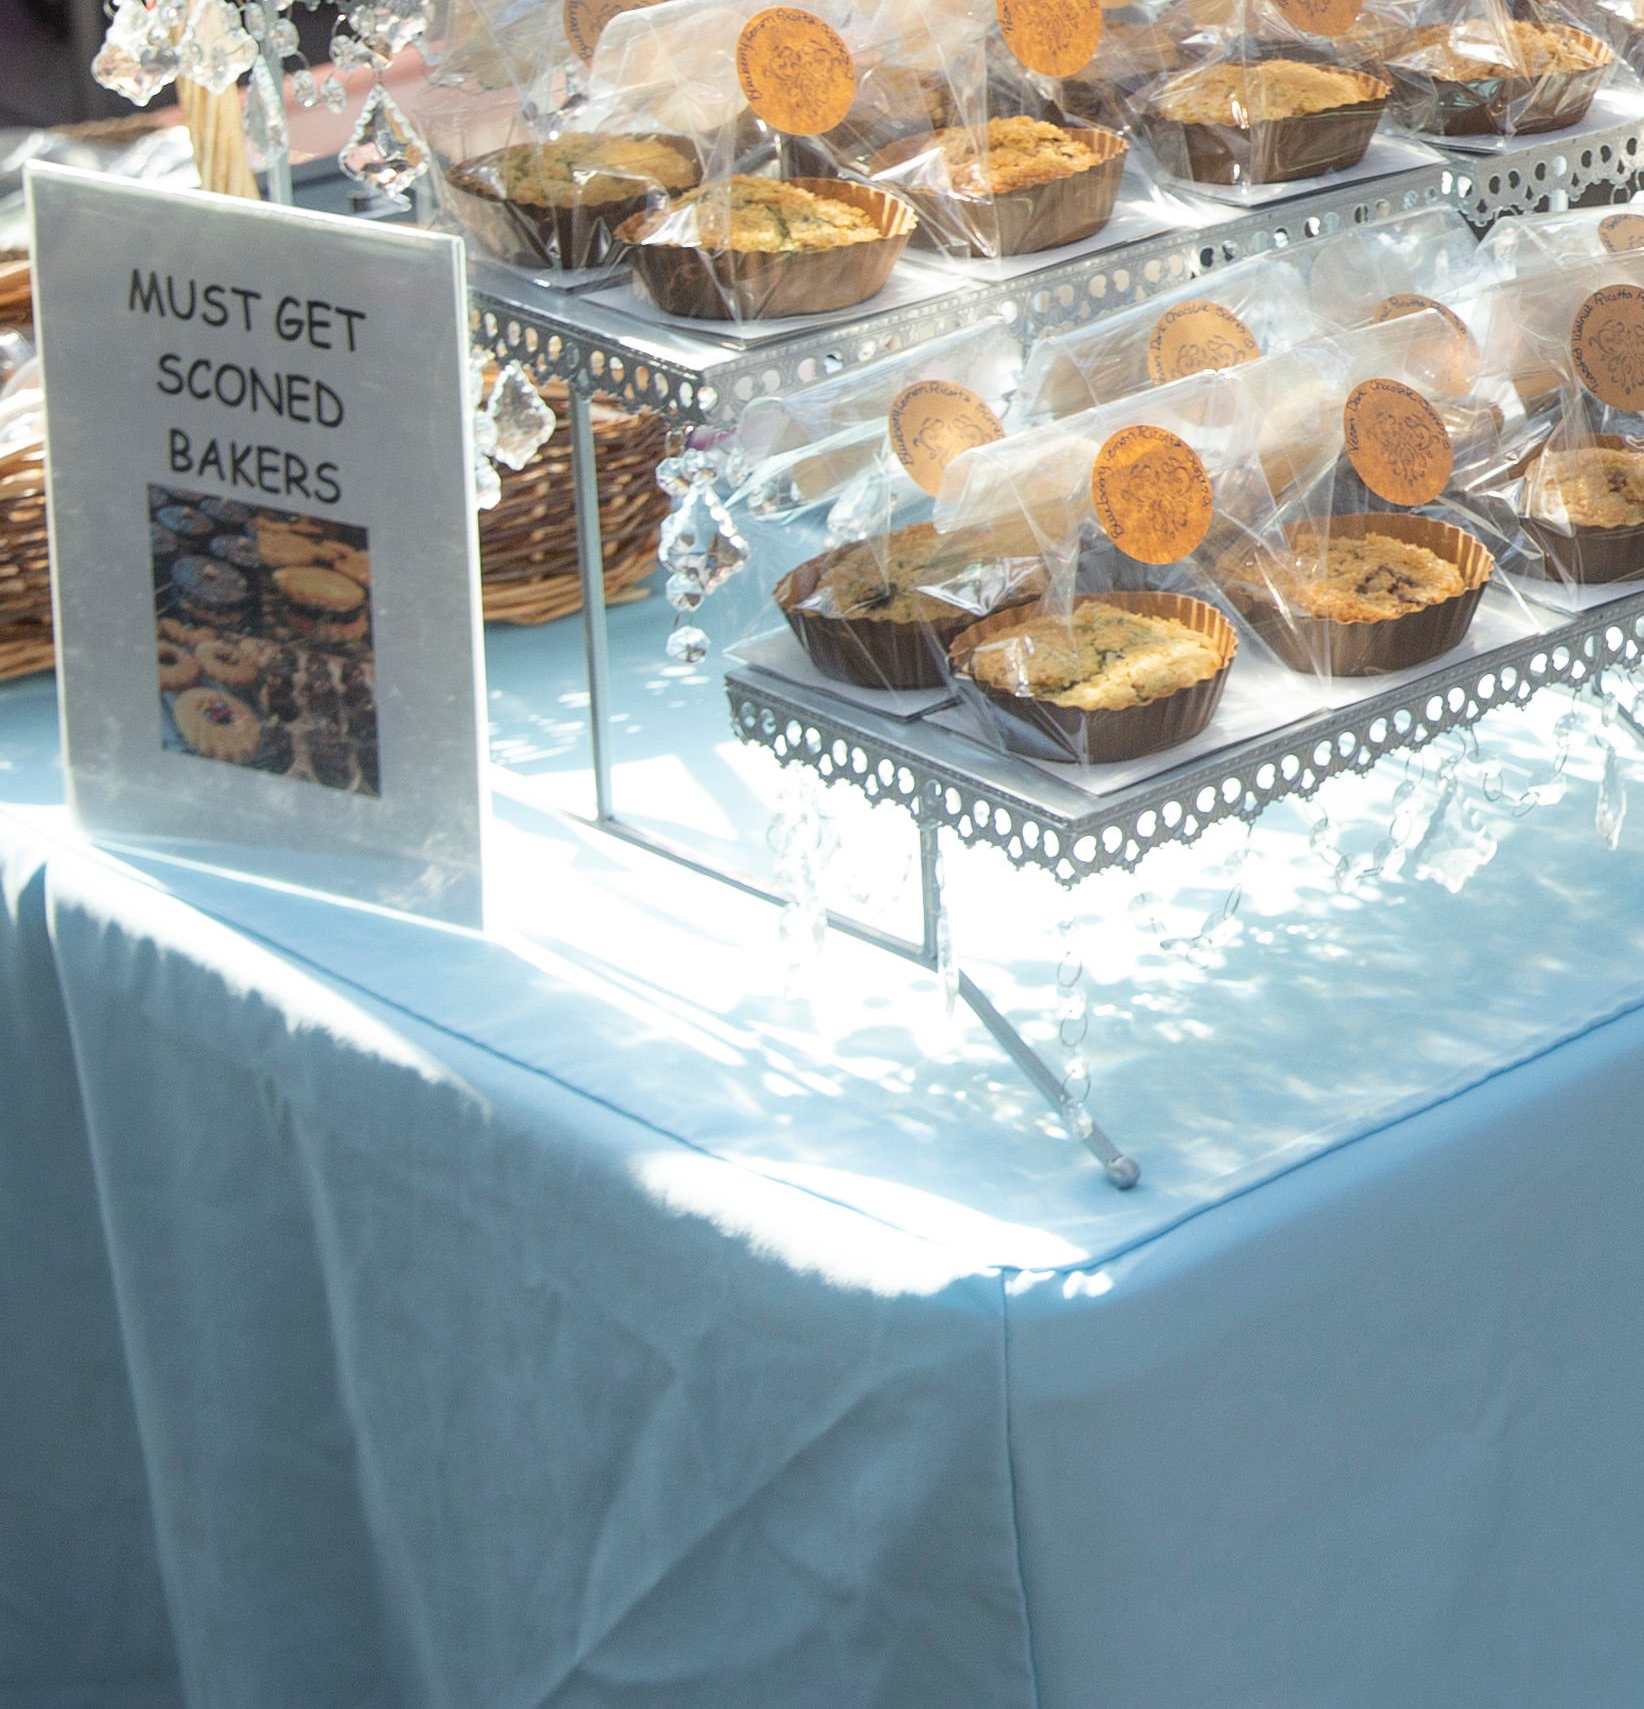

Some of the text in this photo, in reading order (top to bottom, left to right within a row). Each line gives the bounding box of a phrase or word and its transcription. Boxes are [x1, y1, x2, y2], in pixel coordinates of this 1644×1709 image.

[128, 267, 366, 353] MUST GET
[156, 352, 344, 429] SCONED
[168, 427, 341, 505] BAKERS
